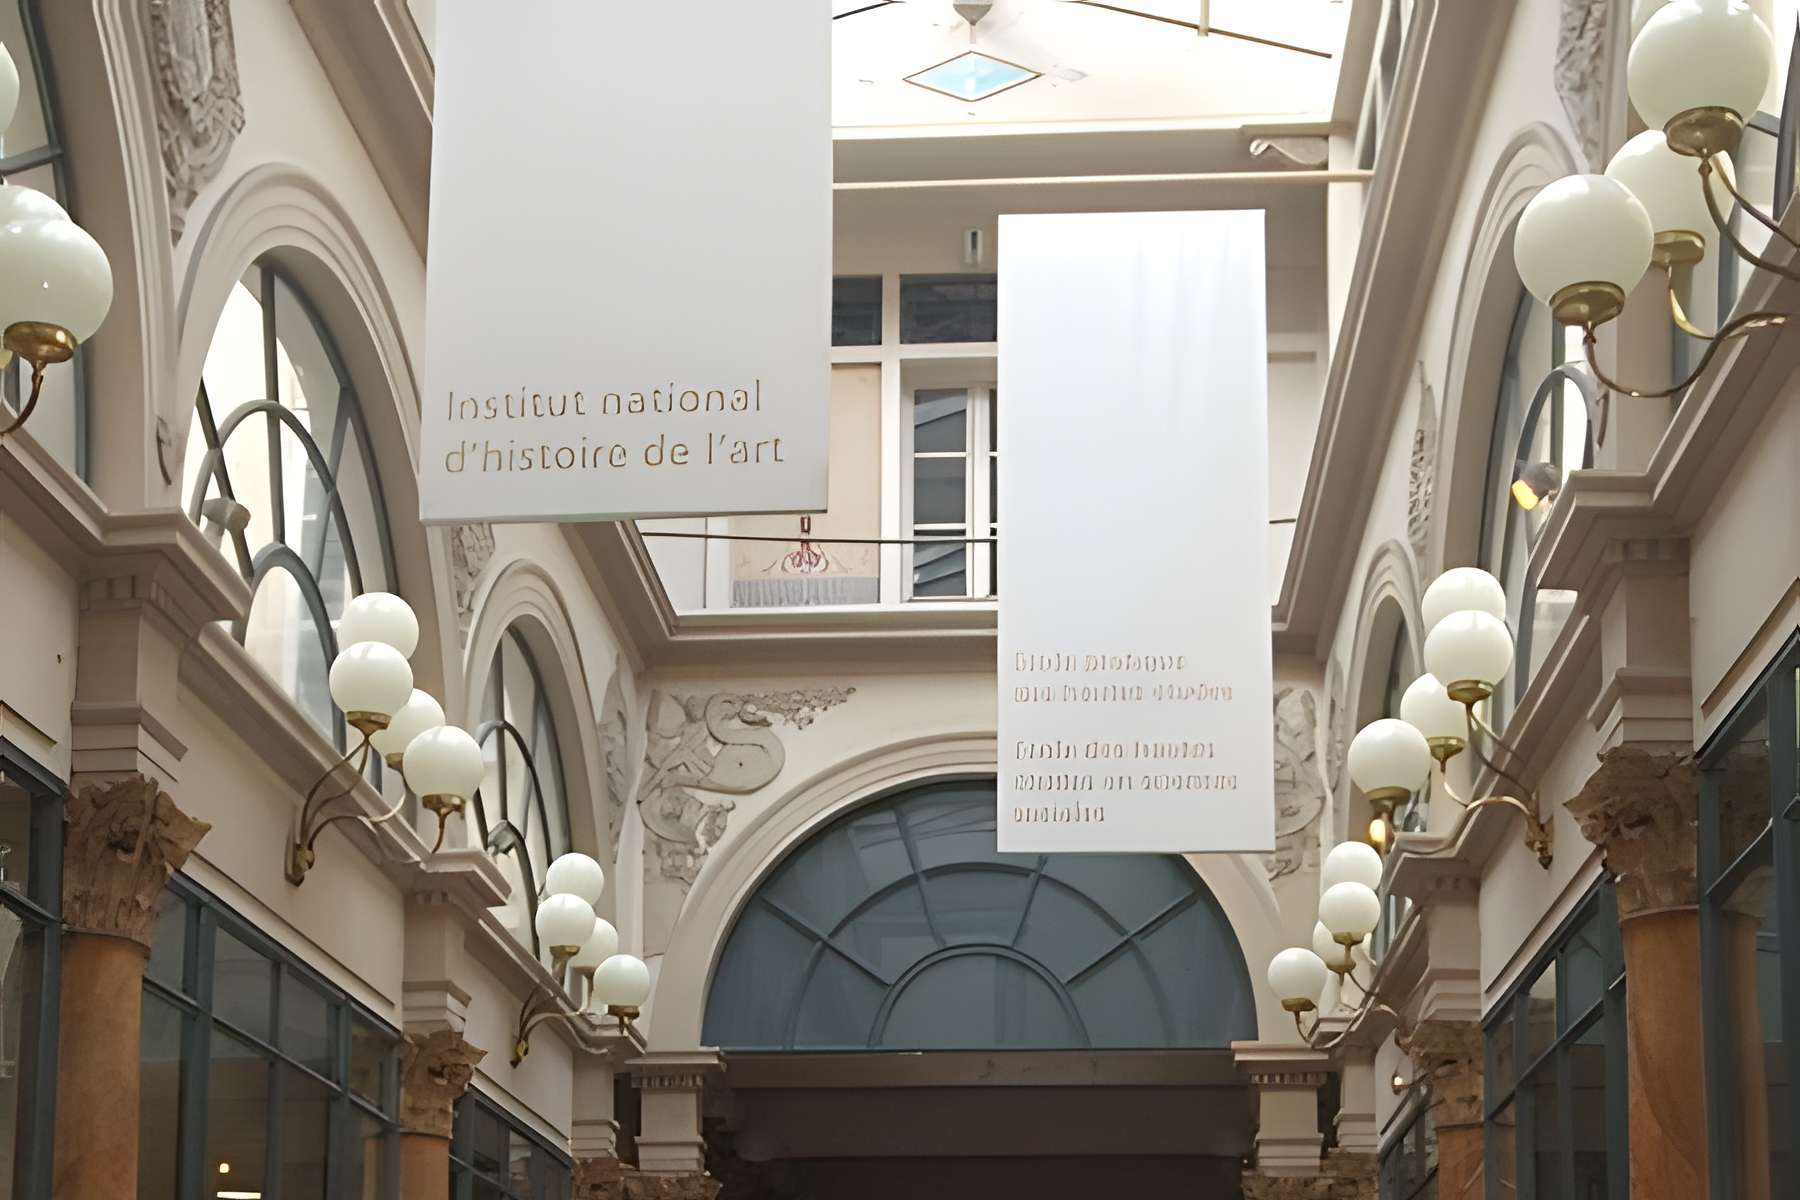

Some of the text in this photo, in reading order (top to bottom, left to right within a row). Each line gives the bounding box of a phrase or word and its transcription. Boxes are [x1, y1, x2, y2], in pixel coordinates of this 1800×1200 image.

[447, 379, 761, 421] Institut national
[643, 433, 690, 467] de
[706, 432, 785, 465] l'art
